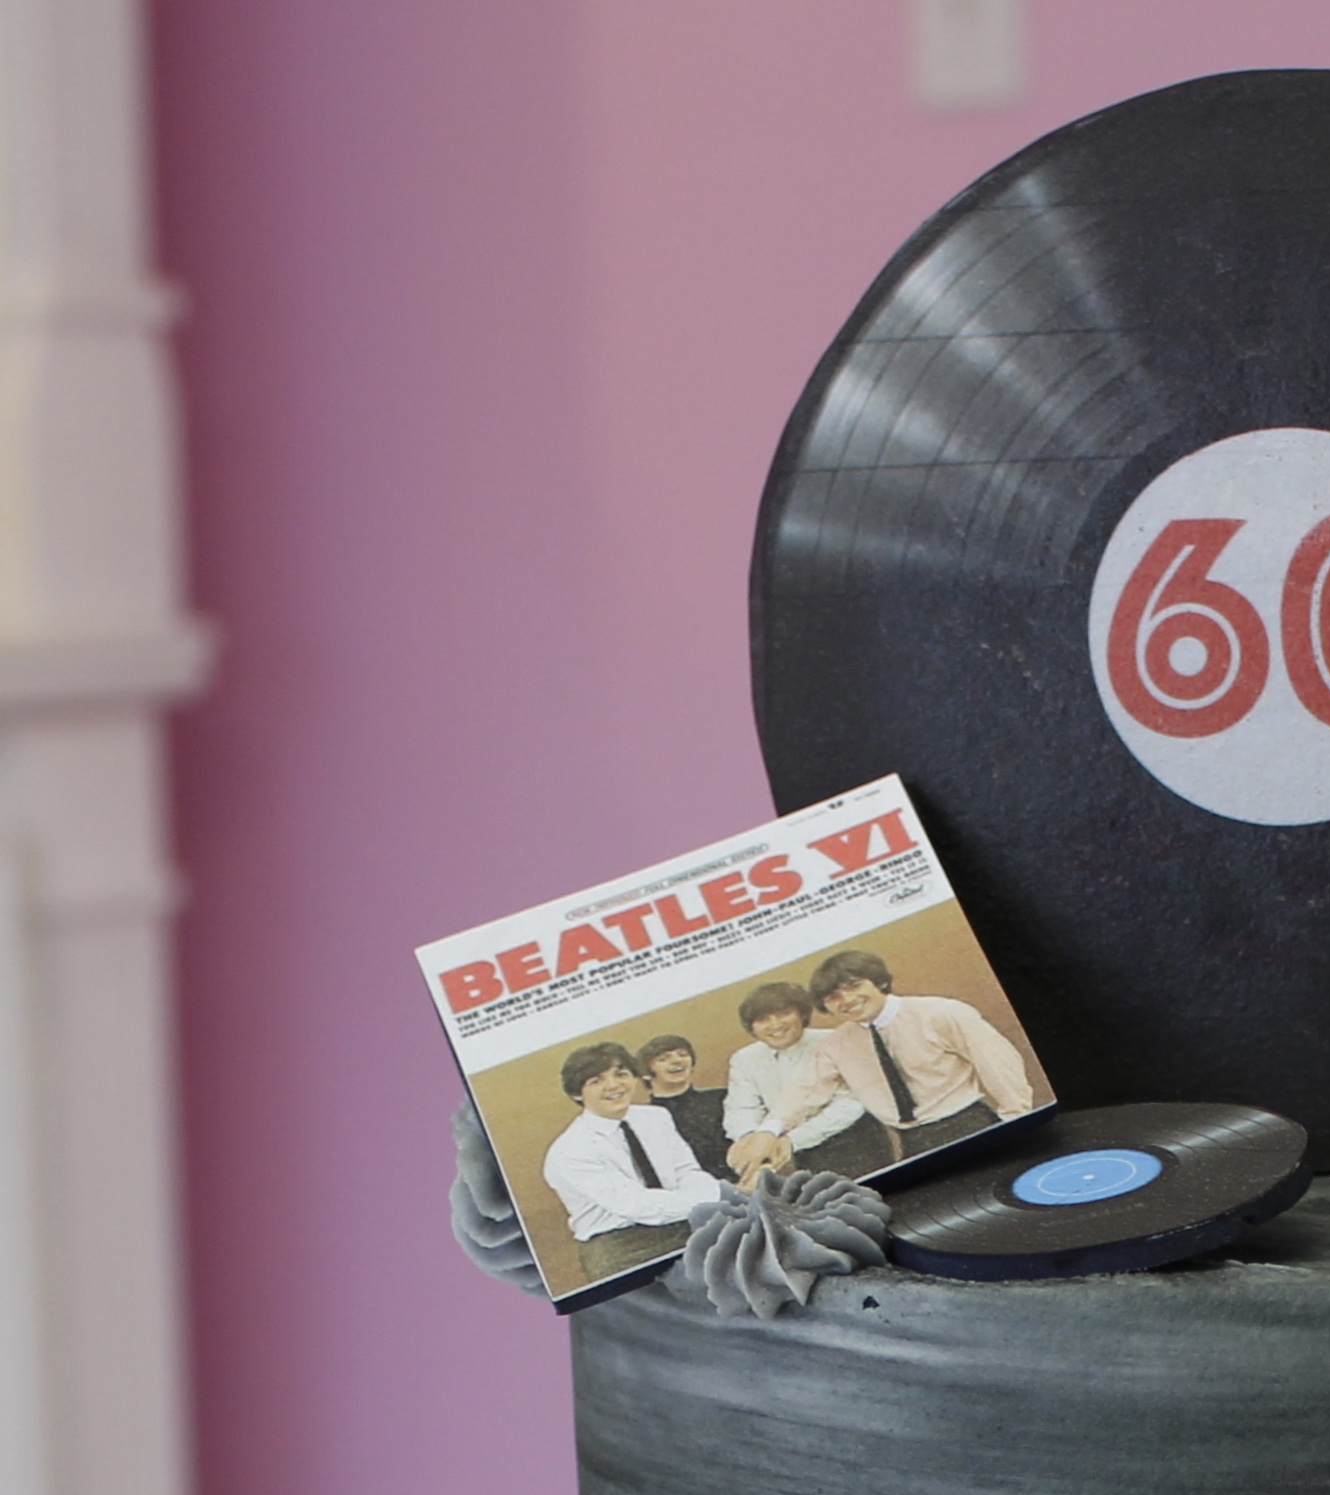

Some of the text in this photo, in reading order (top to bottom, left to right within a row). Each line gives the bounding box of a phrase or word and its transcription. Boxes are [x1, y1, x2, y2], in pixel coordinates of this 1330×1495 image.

[440, 808, 918, 1013] BEATLES VI
[454, 1010, 480, 1025] THE
[483, 987, 544, 1015] WORLD'S
[547, 972, 585, 992] MOST
[588, 948, 652, 978] POPULAR
[878, 848, 924, 871] RINGO
